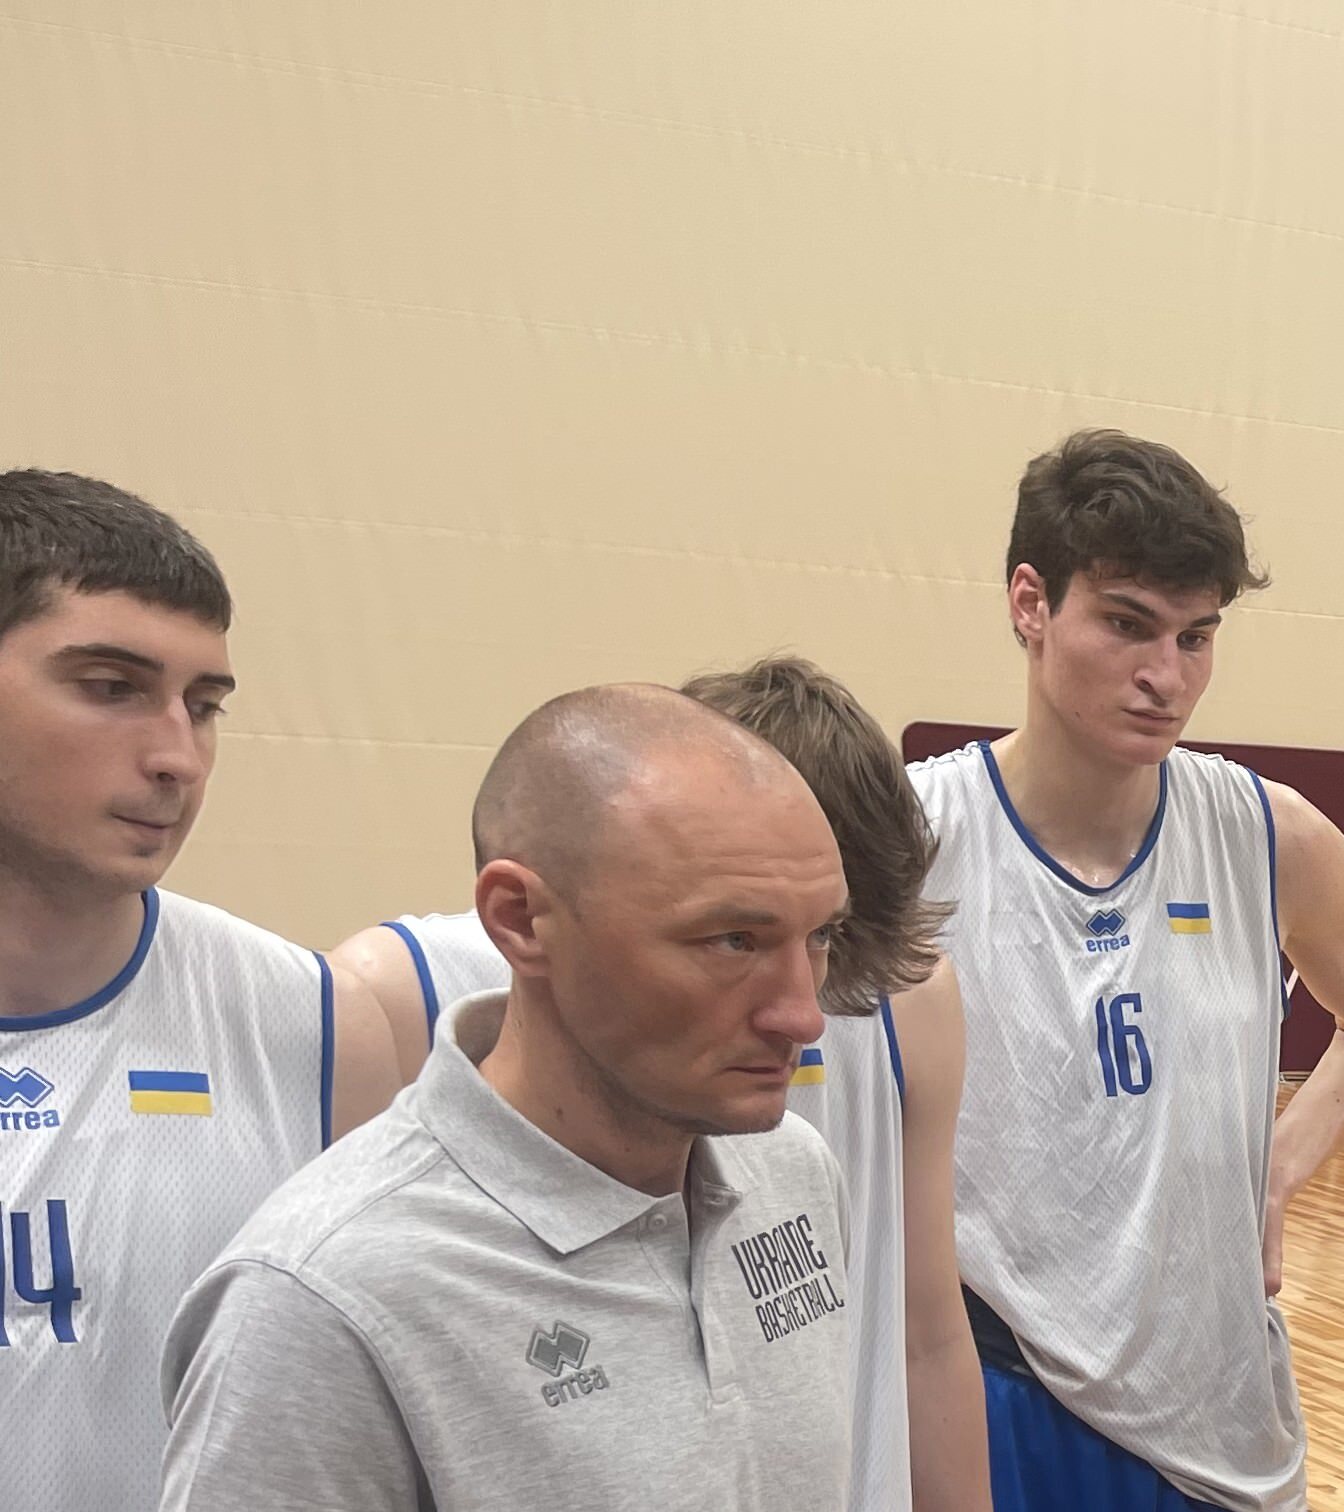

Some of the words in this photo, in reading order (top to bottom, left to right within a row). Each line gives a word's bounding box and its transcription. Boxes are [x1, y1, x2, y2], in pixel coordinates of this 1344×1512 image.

[1086, 934, 1130, 952] errea
[1095, 993, 1152, 1097] 16
[0, 1108, 60, 1130] rrea
[731, 1214, 827, 1299] UKRAINE
[755, 1274, 844, 1342] BASKETBALL
[541, 1364, 610, 1407] errea
